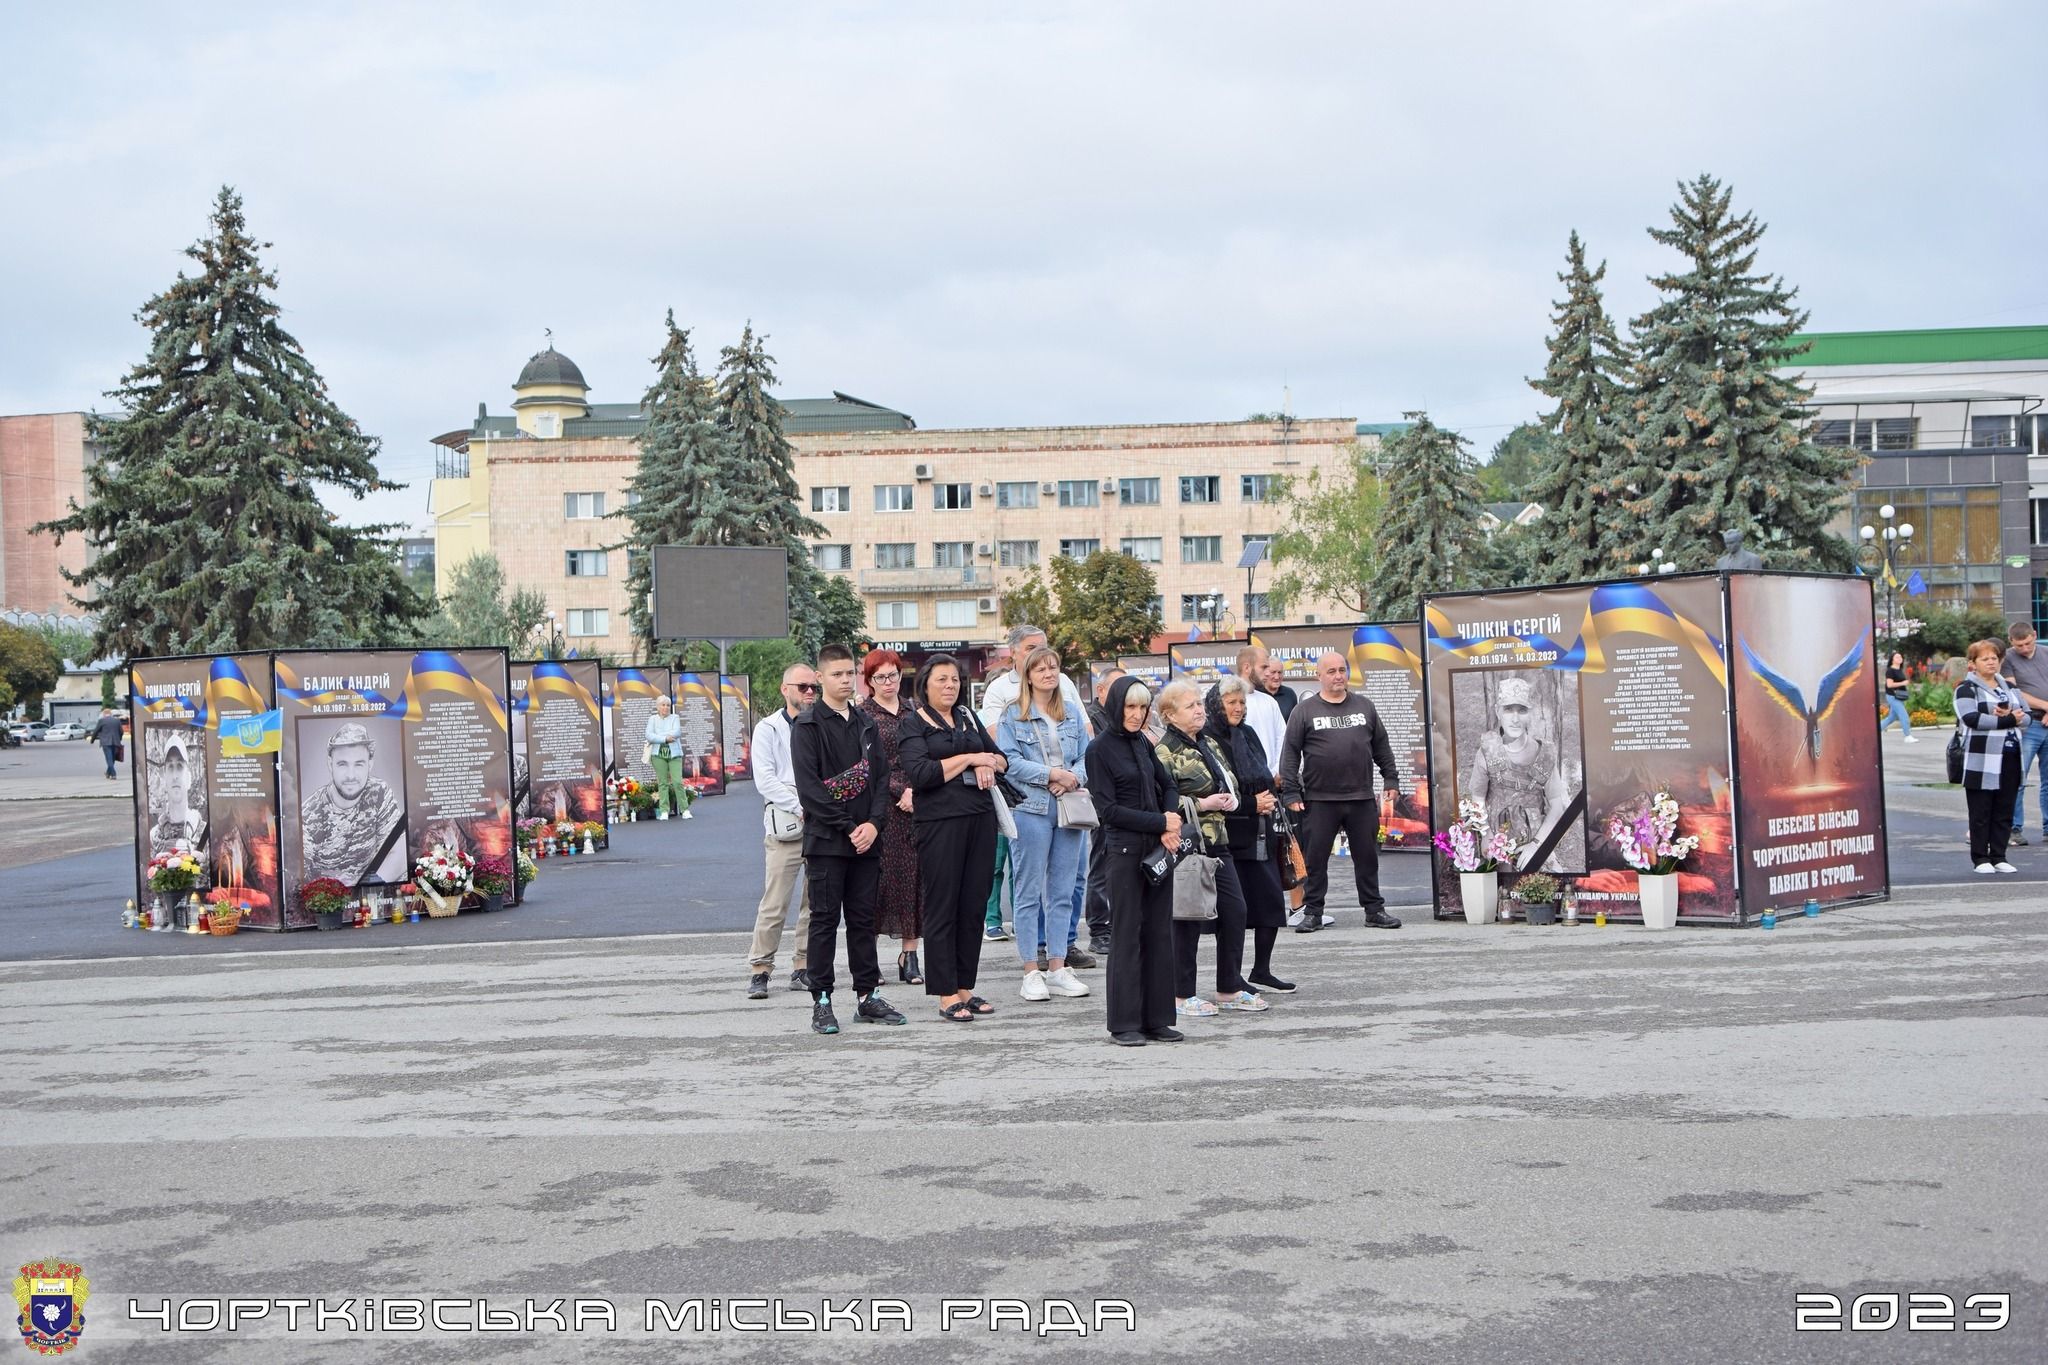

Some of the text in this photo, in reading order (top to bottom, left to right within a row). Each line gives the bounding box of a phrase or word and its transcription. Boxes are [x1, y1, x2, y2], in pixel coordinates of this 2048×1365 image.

[1458, 614, 1561, 639] ЧІЛІКІН СЕРГІЙ
[876, 642, 908, 652] ANDI
[1270, 648, 1302, 660] РУЩАК
[1184, 658, 1216, 667] КИРИЛЮК
[1470, 654, 1508, 665] 28.01.1974
[1516, 651, 1557, 662] 14.03.2023
[146, 680, 201, 698] РОМАНОВ СЕРГІЙ
[304, 672, 390, 691] БАЛИК АНДРІЙ
[1313, 713, 1367, 730] ENDLESS
[1768, 808, 1859, 837] НЕБЕСНЕ ВІЙСЬКО
[1753, 834, 1874, 868] ЧОРТКІВСЬКОЇ ГРОМАДИ
[1769, 864, 1864, 895] НАВІКИ В СТРОЮ...
